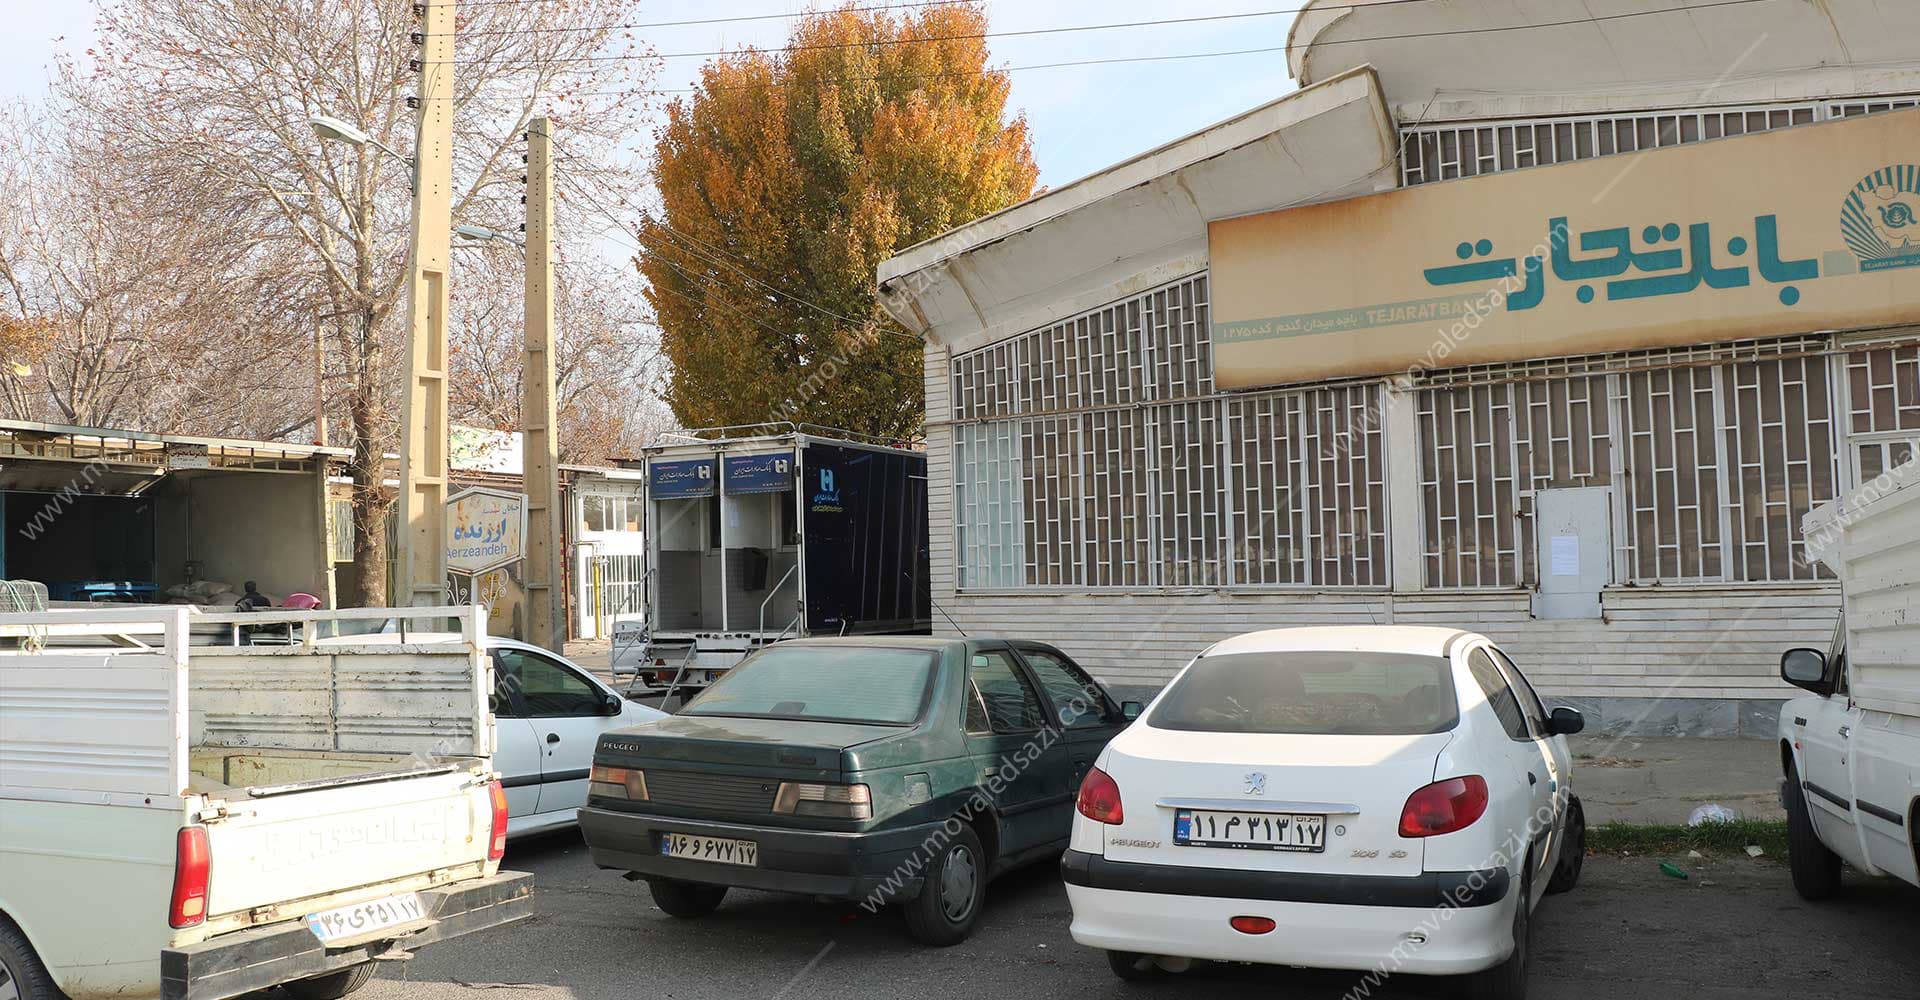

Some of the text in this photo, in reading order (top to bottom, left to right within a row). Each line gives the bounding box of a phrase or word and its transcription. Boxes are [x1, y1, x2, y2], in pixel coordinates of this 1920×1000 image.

[1423, 214, 1819, 312] بانک تجارت
[1366, 303, 1437, 324] TEJARAT
[454, 518, 507, 543] ارزنده
[602, 741, 640, 751] PEUGEOT
[1110, 837, 1162, 849] PEUGEOT
[1350, 849, 1379, 859] 206
